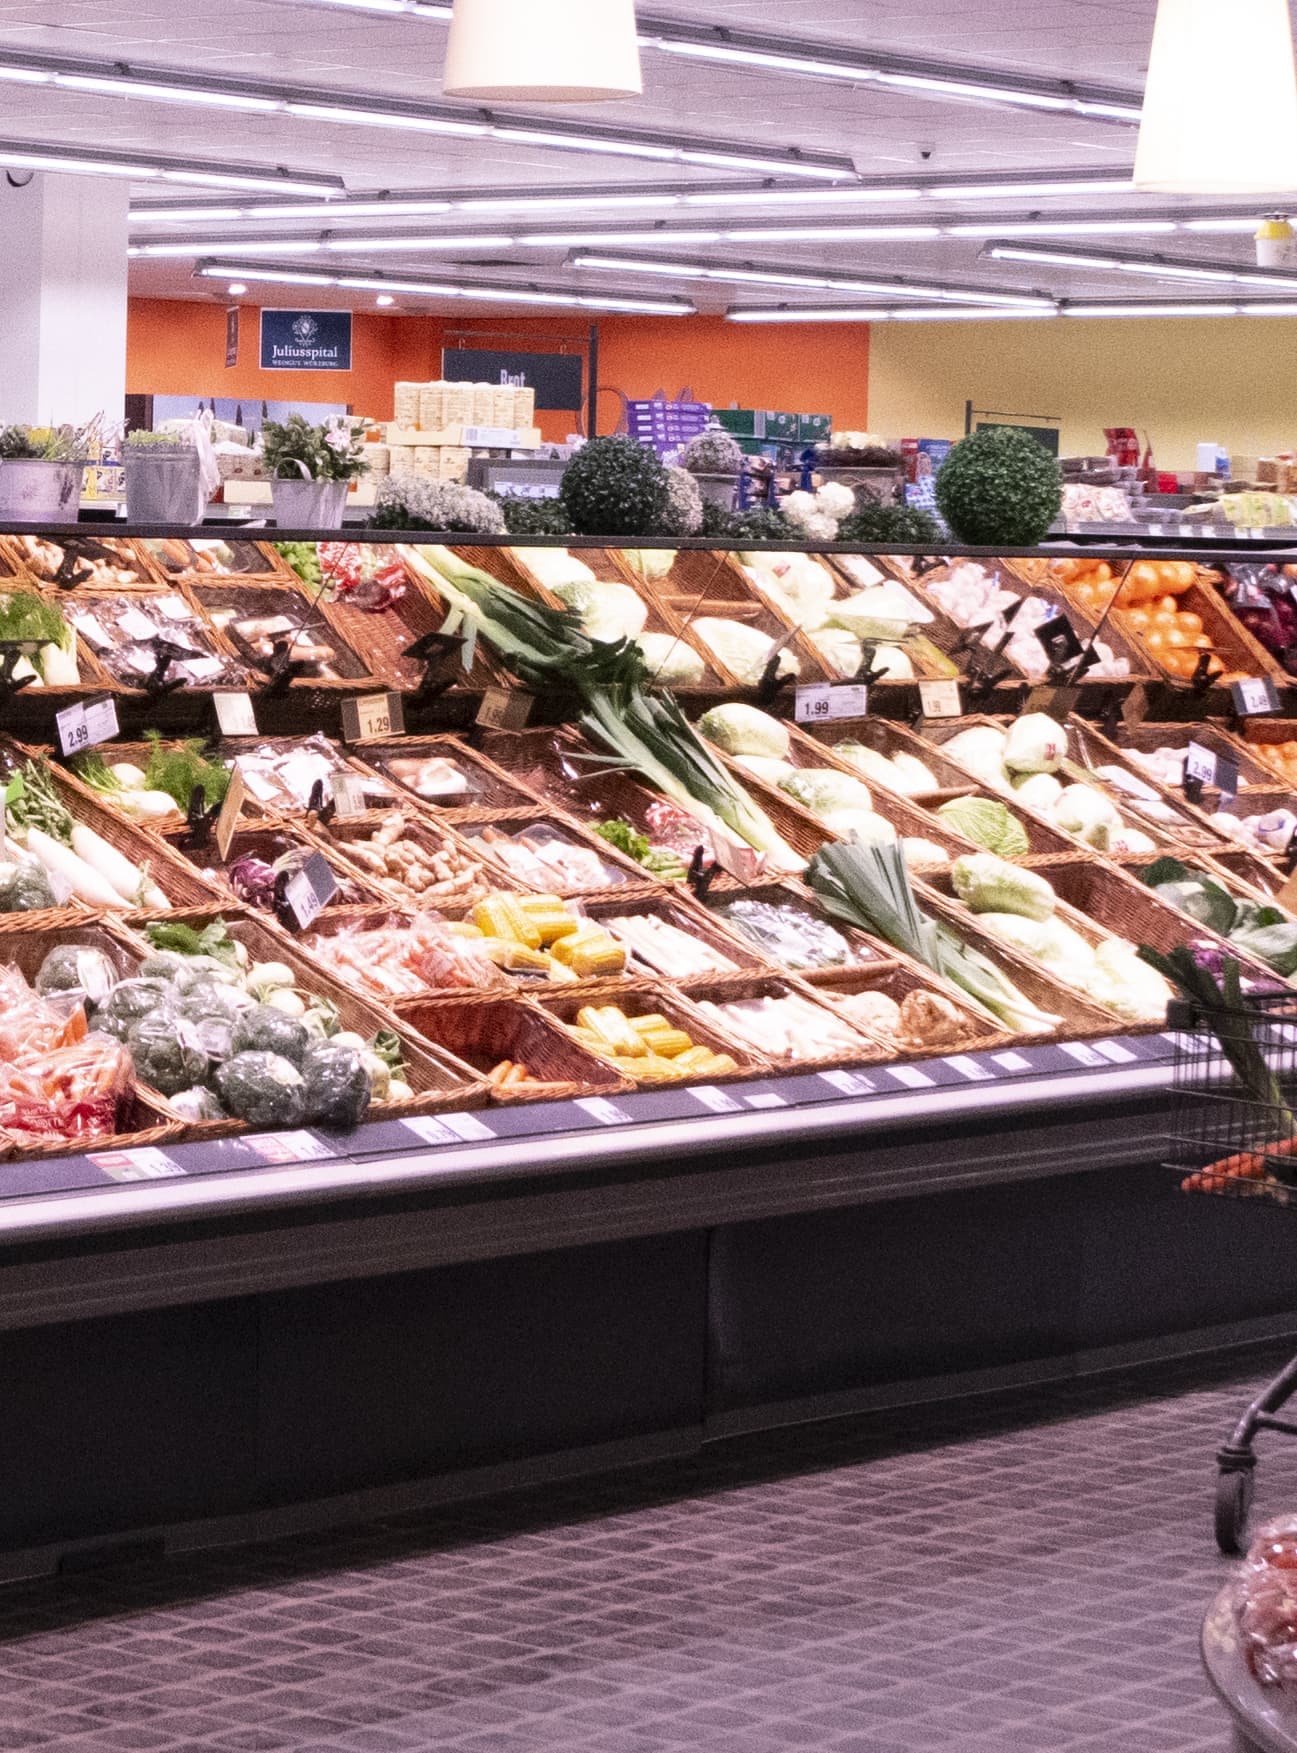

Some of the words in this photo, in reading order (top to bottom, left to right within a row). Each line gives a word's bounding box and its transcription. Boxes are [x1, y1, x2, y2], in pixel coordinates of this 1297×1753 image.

[272, 345, 338, 361] Juliusspital
[805, 702, 829, 715] 1.99
[367, 716, 389, 734] 1.29
[67, 725, 89, 747] 2.99
[1193, 761, 1213, 781] 2.99
